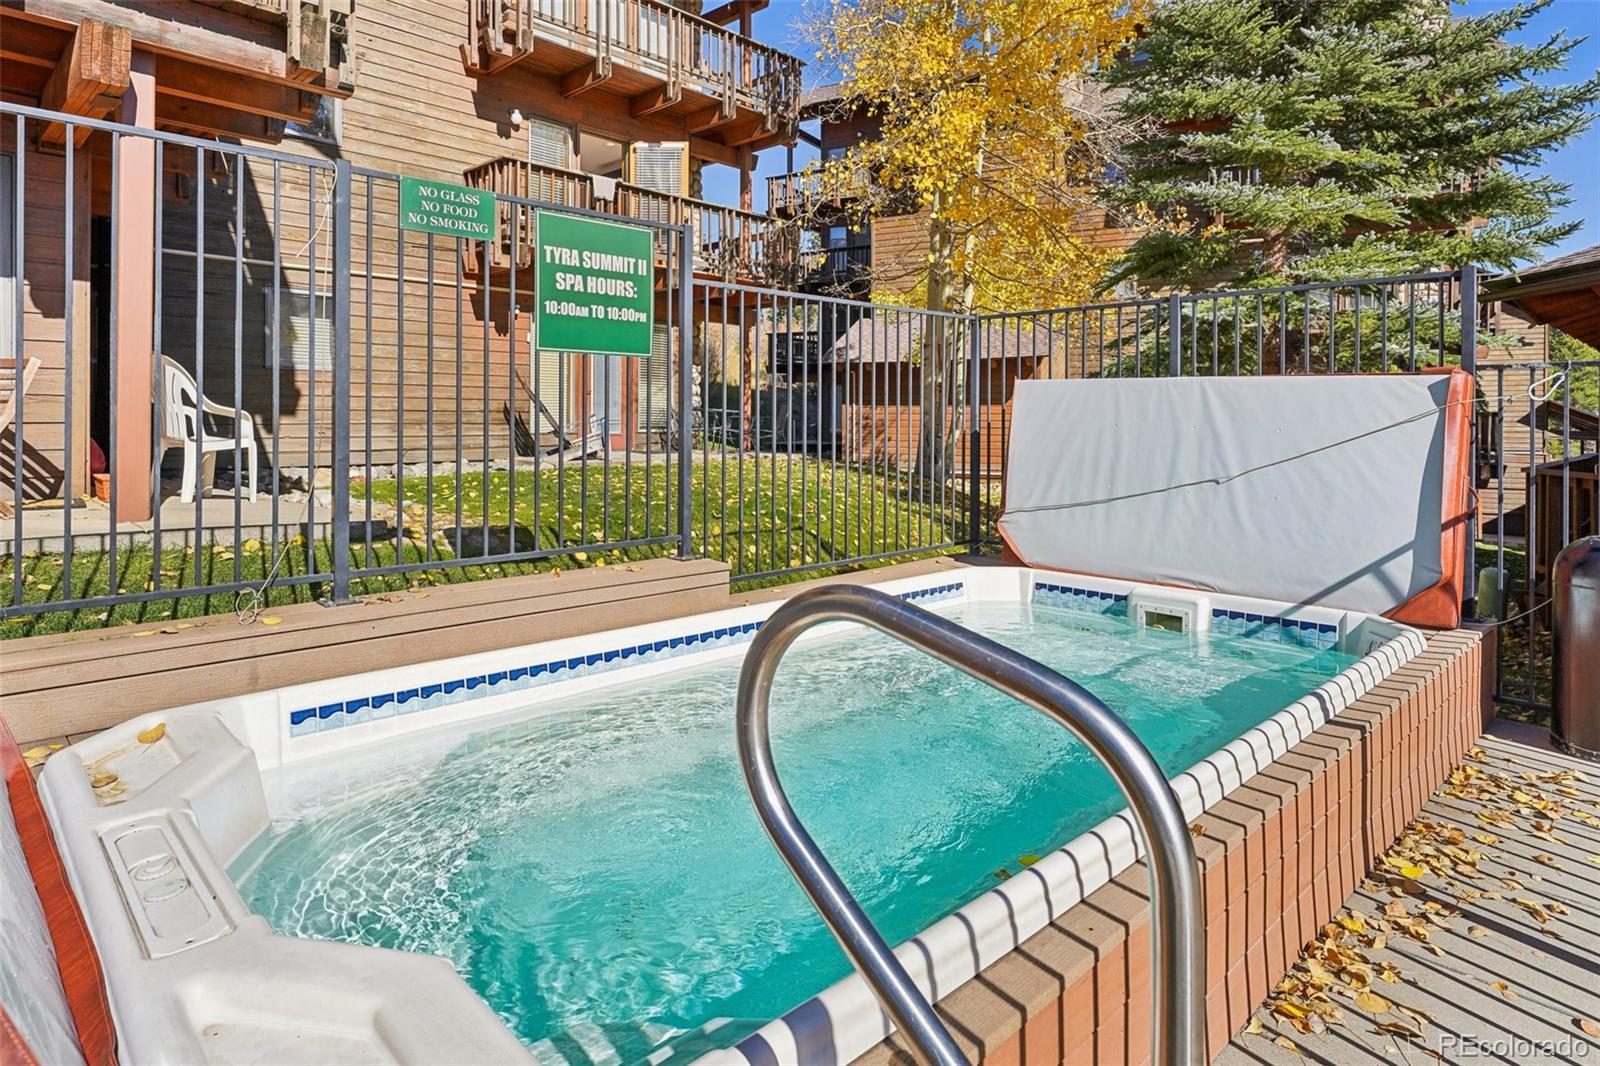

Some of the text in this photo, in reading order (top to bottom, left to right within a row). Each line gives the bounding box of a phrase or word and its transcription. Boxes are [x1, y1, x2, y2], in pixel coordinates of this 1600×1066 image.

[418, 185, 480, 206] NO GLASS
[420, 200, 478, 218] NO FOOD
[408, 212, 489, 234] NO SMOKING
[543, 245, 647, 276] TYRA SUMMIT II
[555, 271, 638, 298] SPA HOURS:
[543, 300, 647, 322] 10:00AM TO 10:00PM
